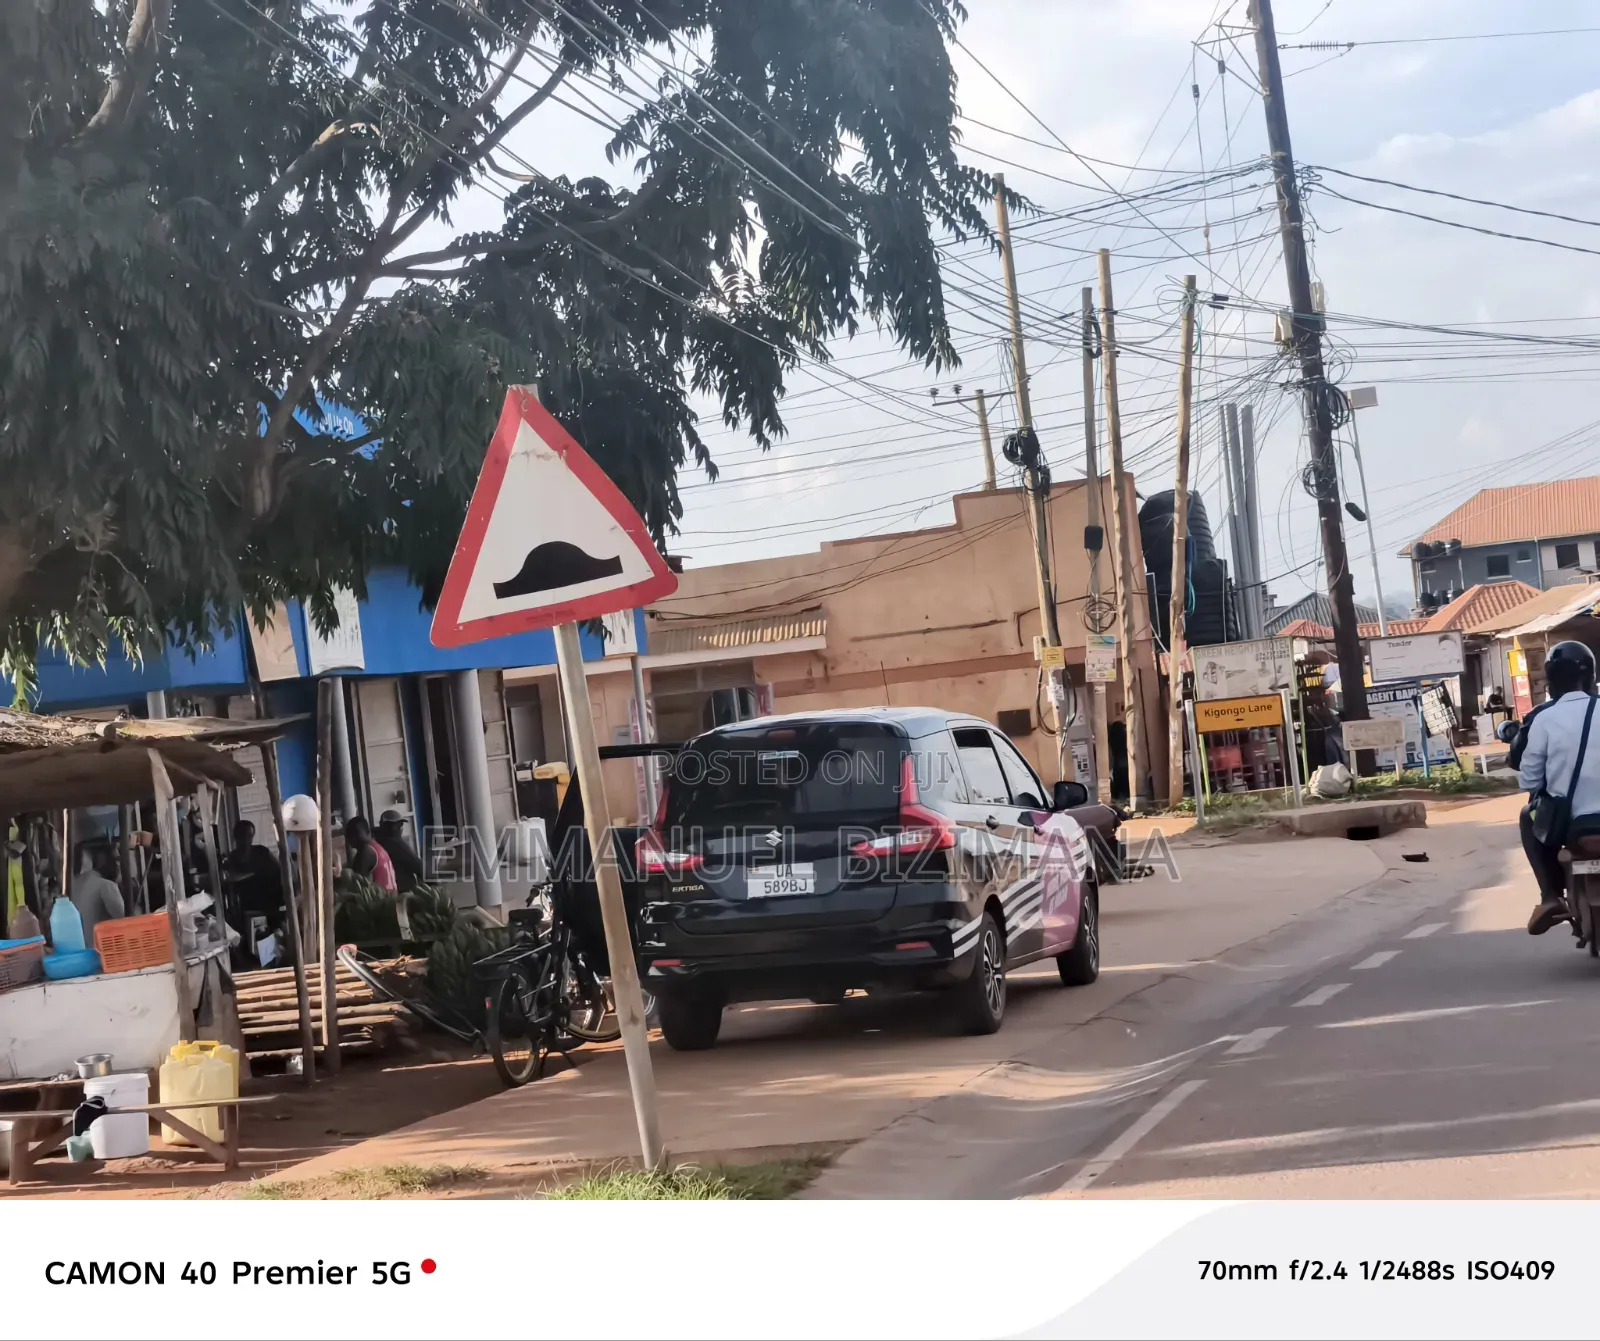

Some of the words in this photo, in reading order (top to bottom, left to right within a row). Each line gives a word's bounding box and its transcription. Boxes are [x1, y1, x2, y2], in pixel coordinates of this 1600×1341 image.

[1366, 690, 1394, 703] AGENT
[1204, 706, 1245, 718] Kigongo
[1248, 704, 1273, 713] Lane
[776, 864, 793, 878] UA
[672, 884, 704, 893] ERTIGA
[764, 878, 807, 894] 589BJ
